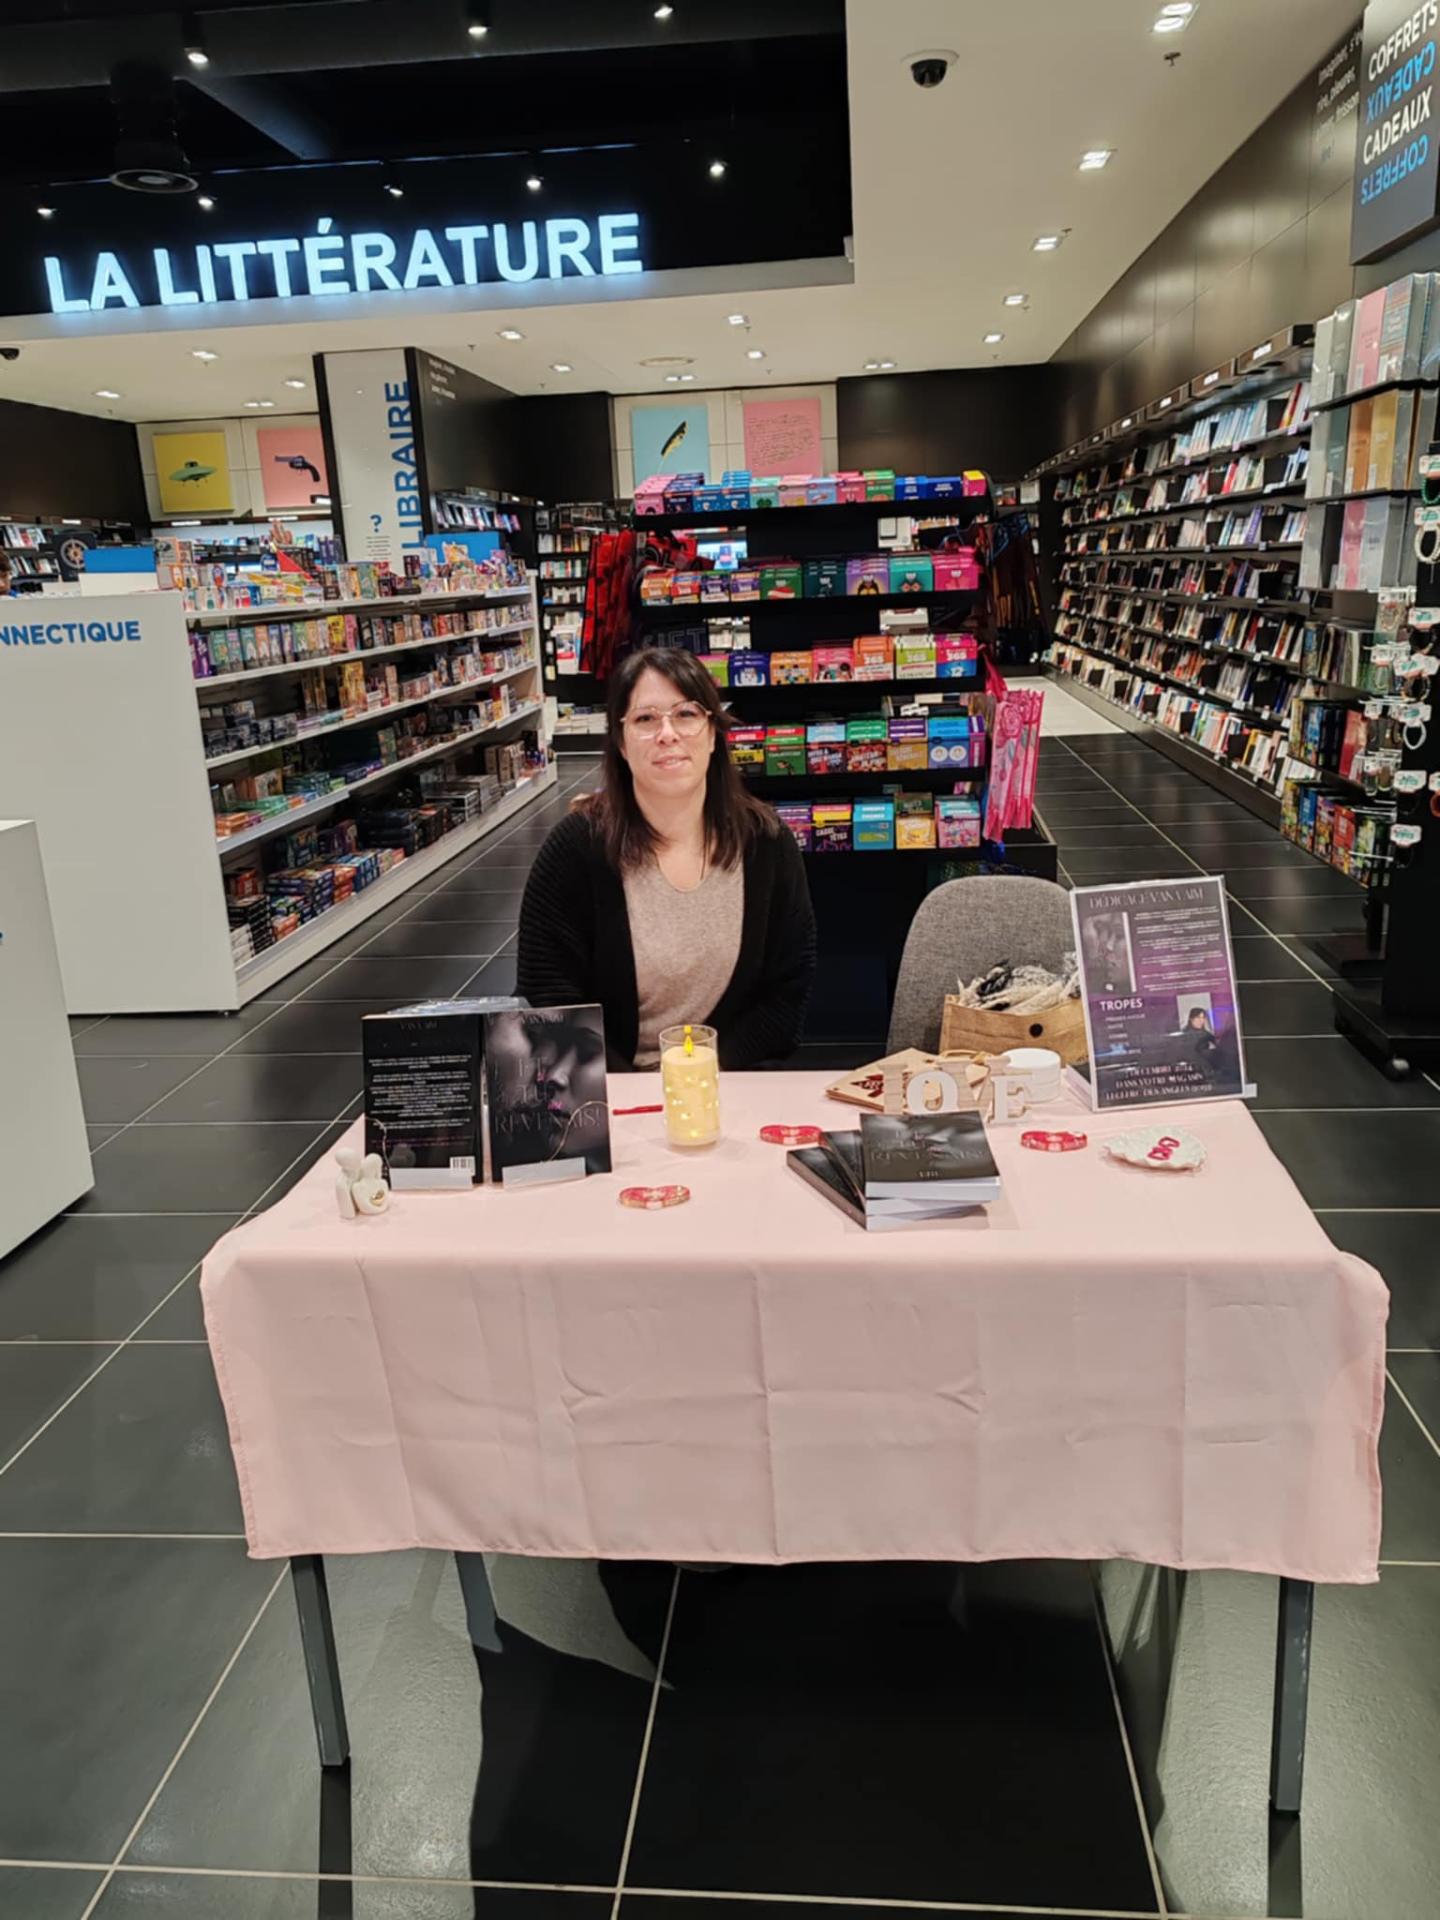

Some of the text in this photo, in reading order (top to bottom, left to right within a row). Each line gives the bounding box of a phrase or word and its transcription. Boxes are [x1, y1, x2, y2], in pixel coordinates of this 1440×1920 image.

[1368, 0, 1439, 82] COFFRETS
[1366, 41, 1436, 124] CADEAUX
[1363, 84, 1433, 166] CADEAUX
[1360, 134, 1429, 206] COFFRETS
[44, 217, 643, 314] LA LITTÉRATURE
[385, 380, 424, 549] LIBRAIRE
[1099, 997, 1143, 1012] TROPES
